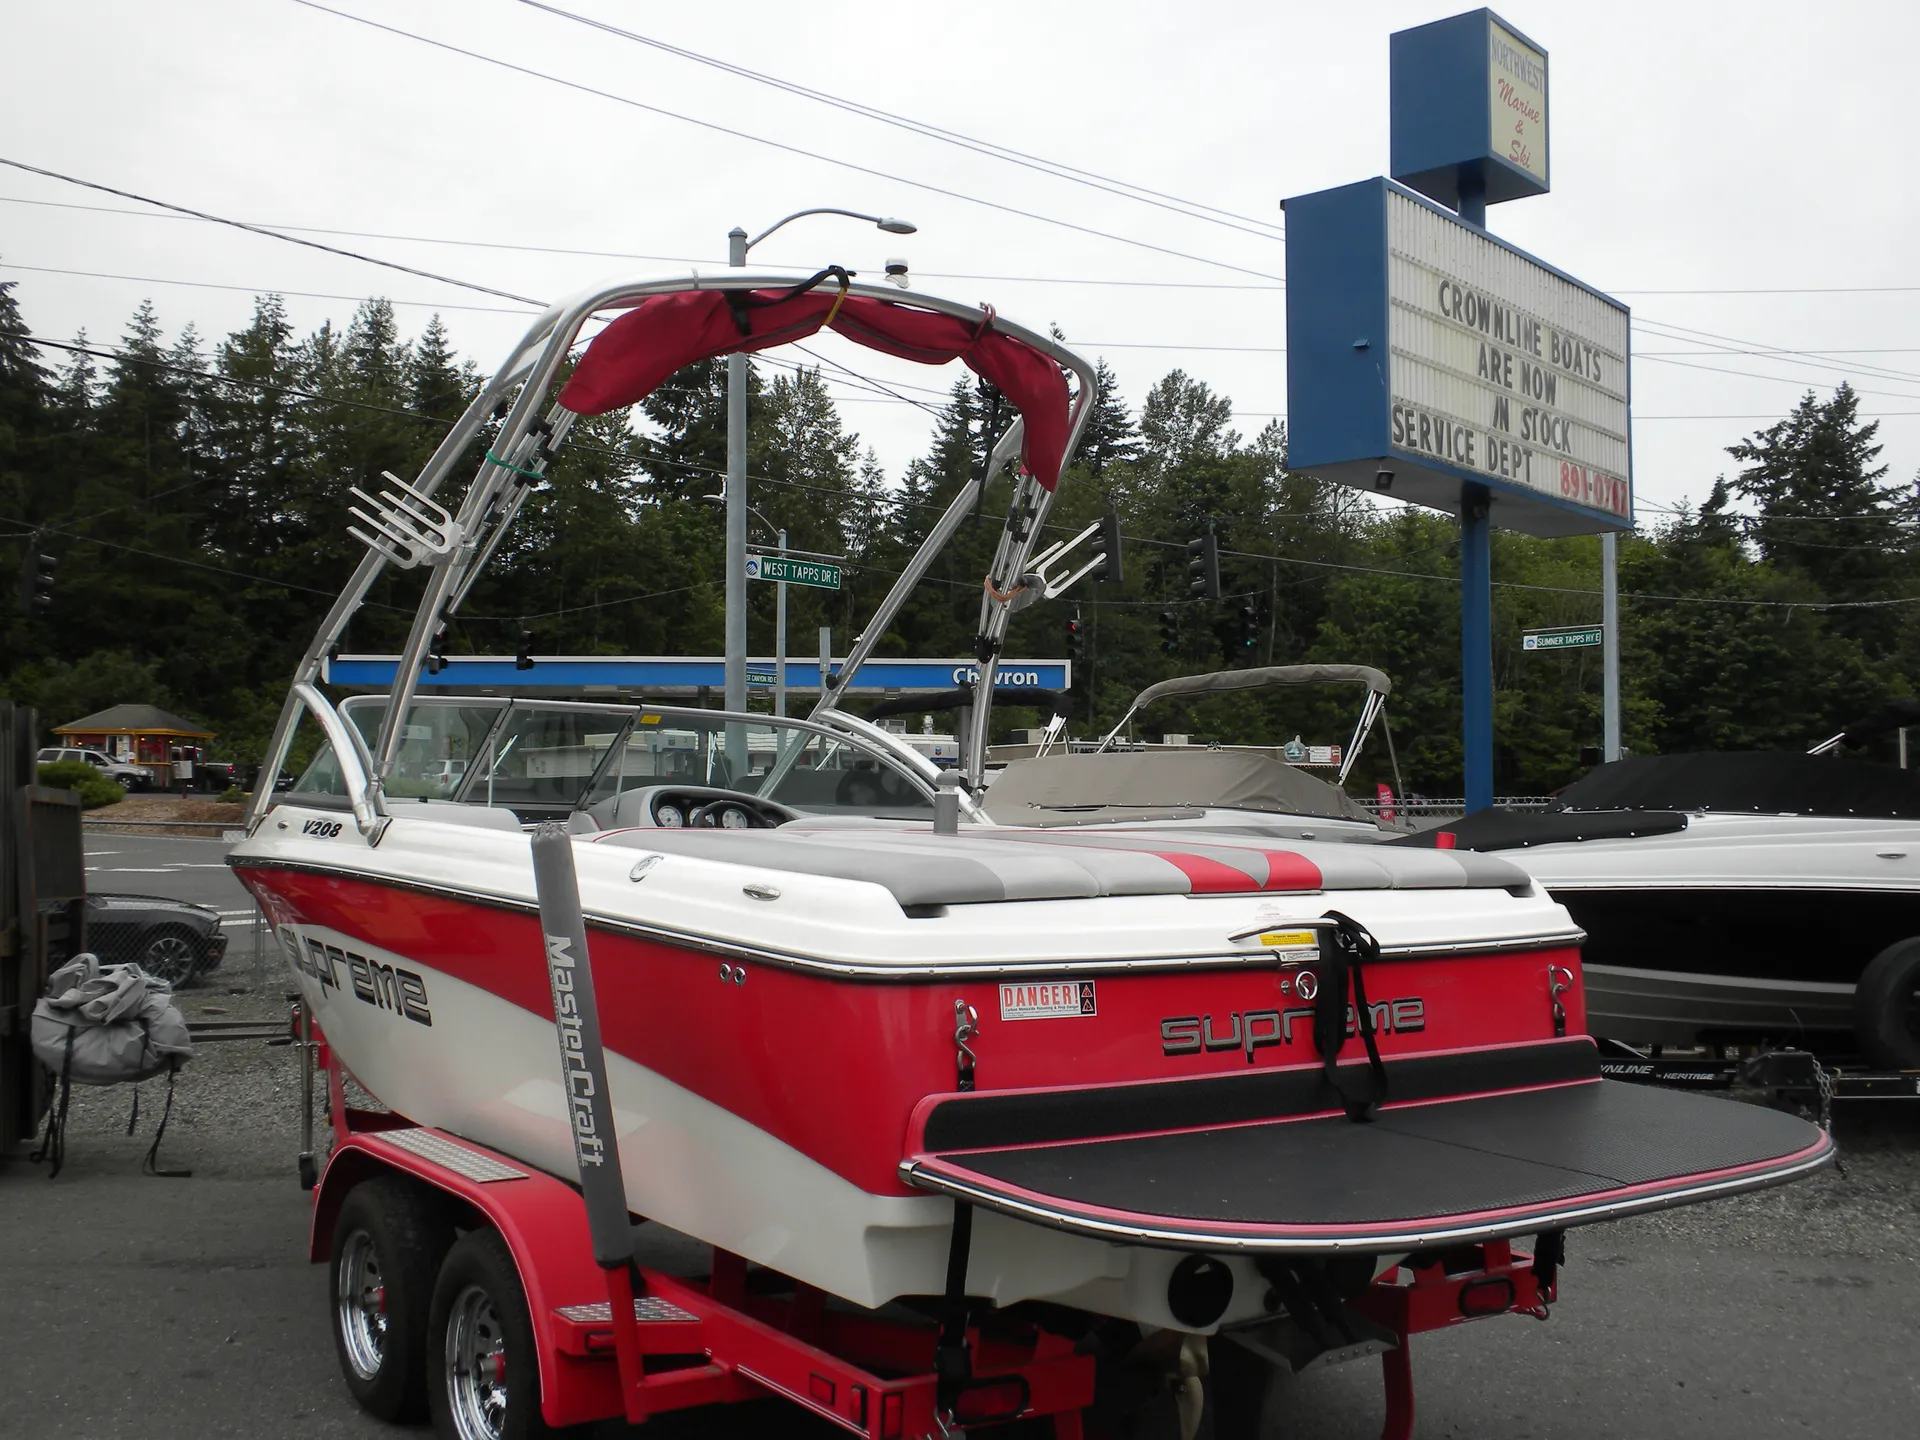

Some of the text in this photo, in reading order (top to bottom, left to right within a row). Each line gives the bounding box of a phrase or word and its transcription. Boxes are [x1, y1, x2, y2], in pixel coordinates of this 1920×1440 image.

[1491, 34, 1543, 94] NORTHWEST
[1498, 78, 1539, 123] Marine
[1515, 120, 1523, 135] &
[1509, 140, 1530, 168] Ski
[1439, 279, 1601, 382] CROWNLINE BOATS
[1478, 342, 1556, 405] ARE NOW
[1493, 396, 1571, 453] IN STOCK
[1392, 404, 1474, 466] SERVICE
[1488, 436, 1532, 482] DEPT
[763, 561, 838, 584] WEST TAPPS DR E
[1537, 633, 1600, 646] SUMNER TAPPS HY E
[751, 674, 767, 682] CANYON
[953, 667, 1039, 685] Chvron
[302, 819, 343, 838] V208
[280, 926, 432, 1027] supreme
[1003, 984, 1078, 1007] DANGER!
[547, 934, 604, 1167] MasterCraft
[1663, 1072, 1715, 1080] HERITAGE
